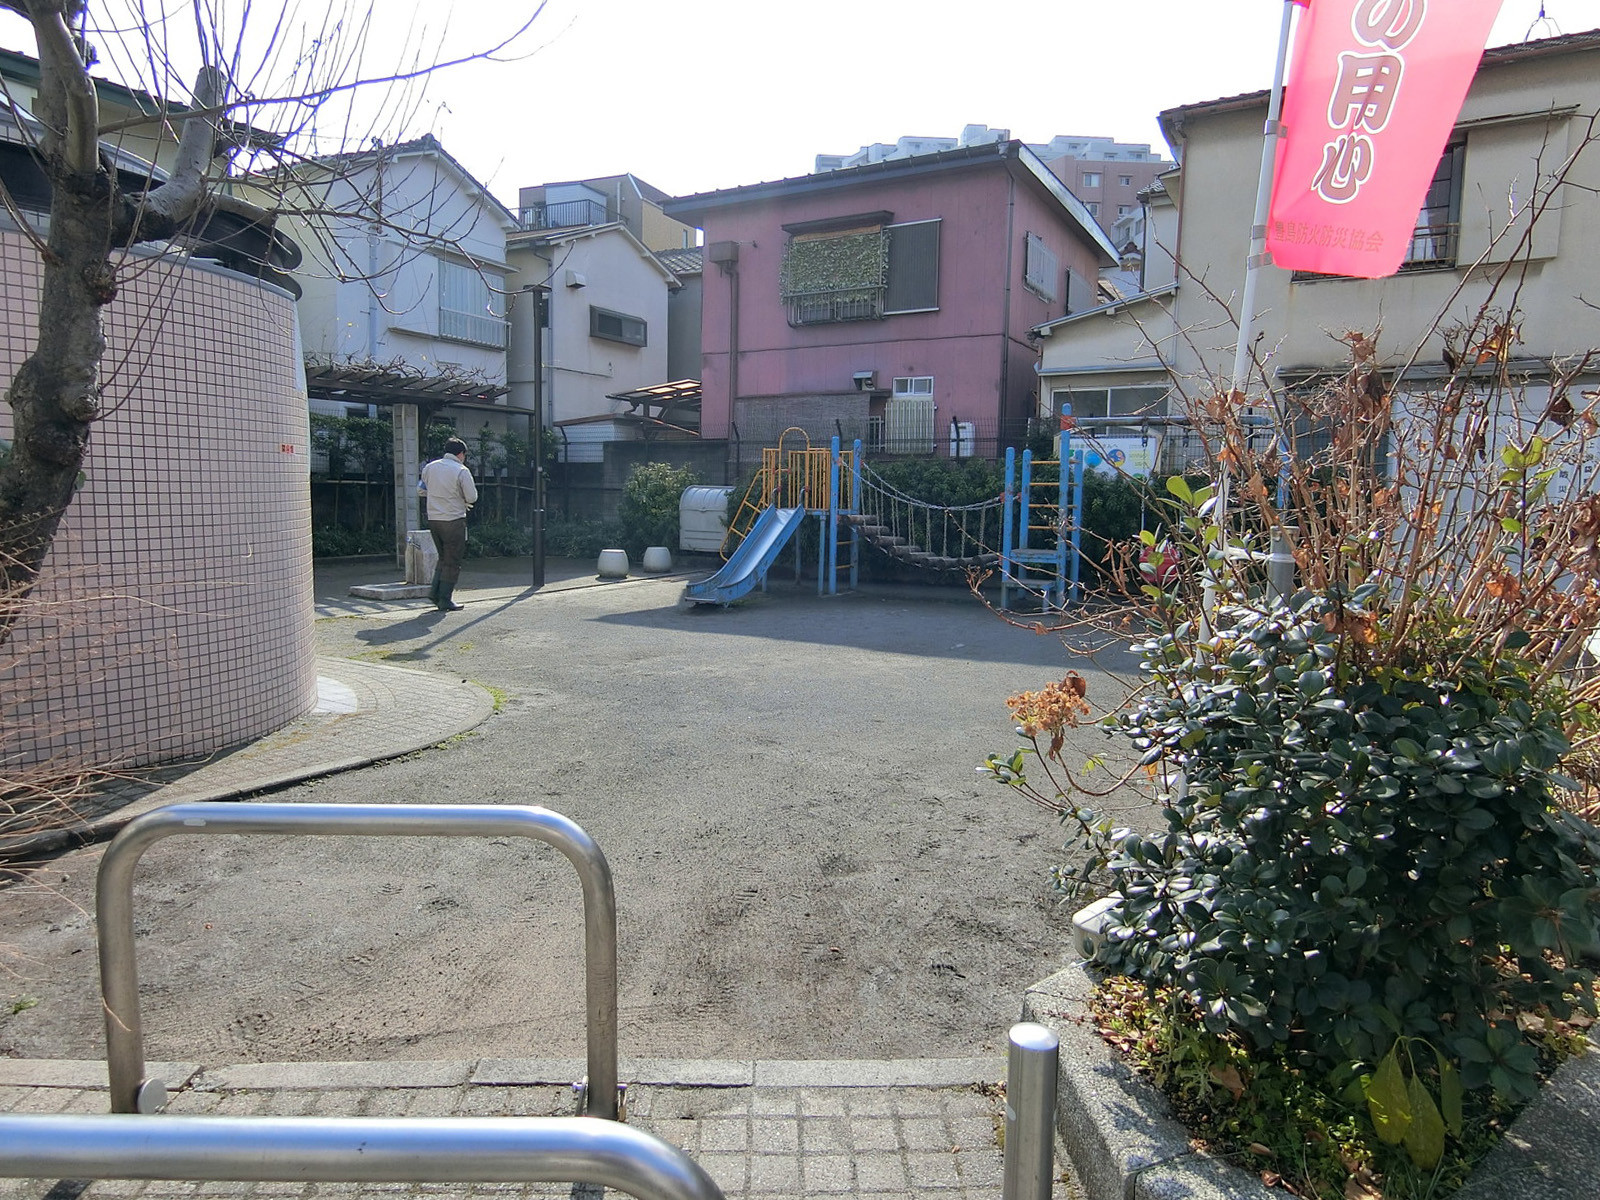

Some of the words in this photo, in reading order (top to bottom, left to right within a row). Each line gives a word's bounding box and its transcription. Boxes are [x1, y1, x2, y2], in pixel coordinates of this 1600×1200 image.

[1311, 0, 1426, 204] の用心
[1274, 220, 1383, 252] 豊島防火防災協会
